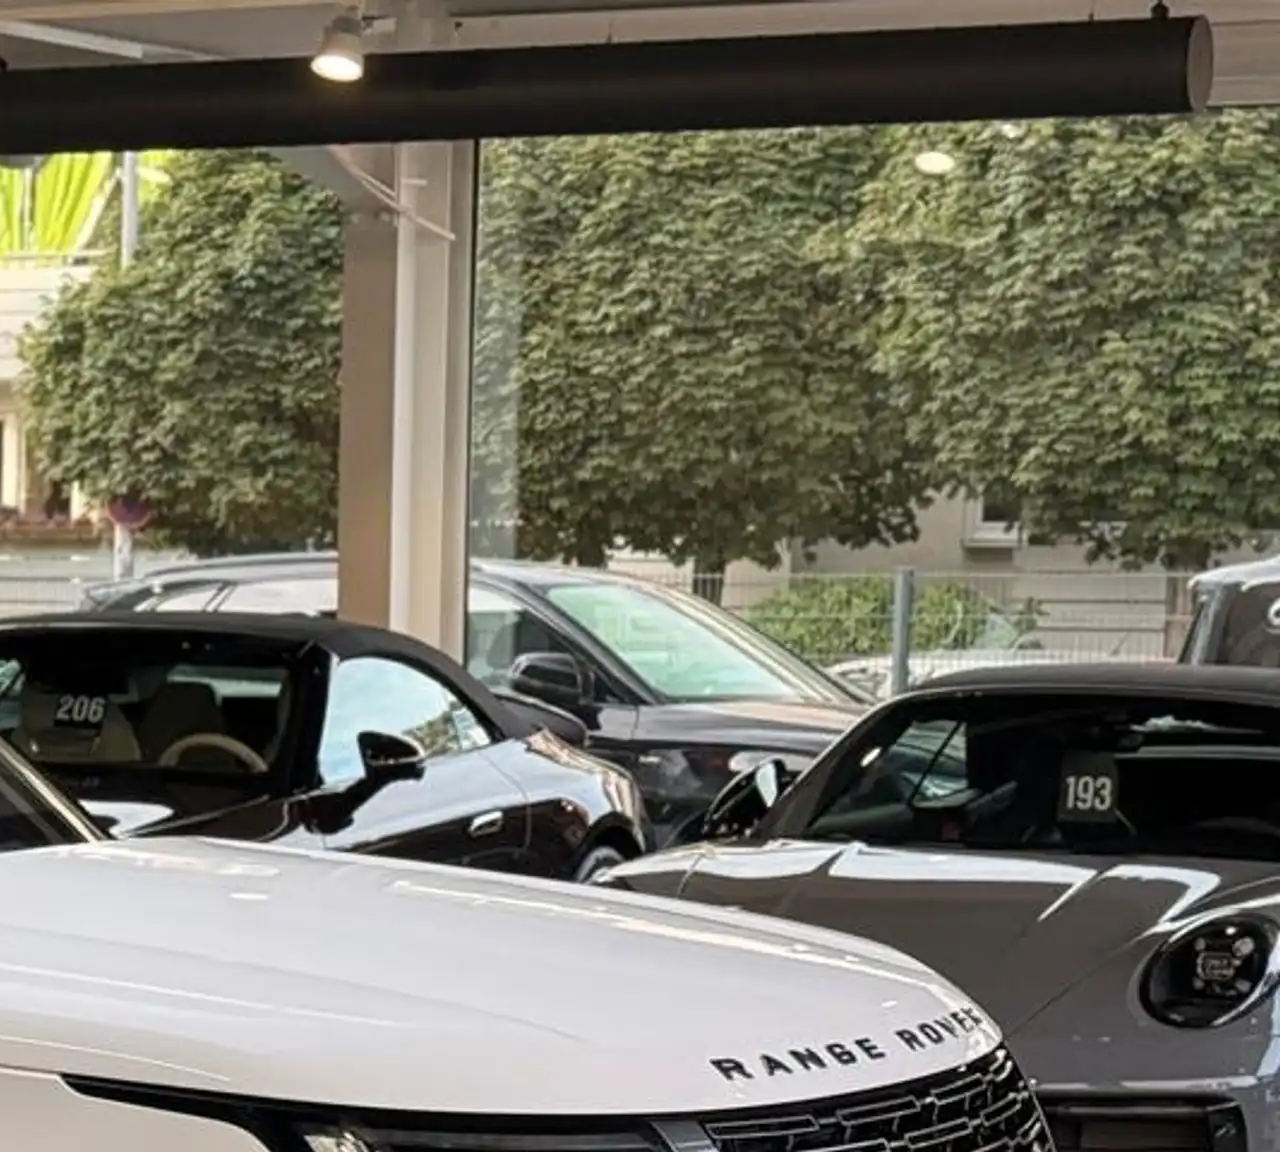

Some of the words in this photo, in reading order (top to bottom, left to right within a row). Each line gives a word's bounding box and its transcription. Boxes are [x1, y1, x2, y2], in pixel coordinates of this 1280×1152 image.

[56, 694, 105, 723] 206
[1066, 775, 1112, 811] 193
[709, 1038, 886, 1080] RANGE
